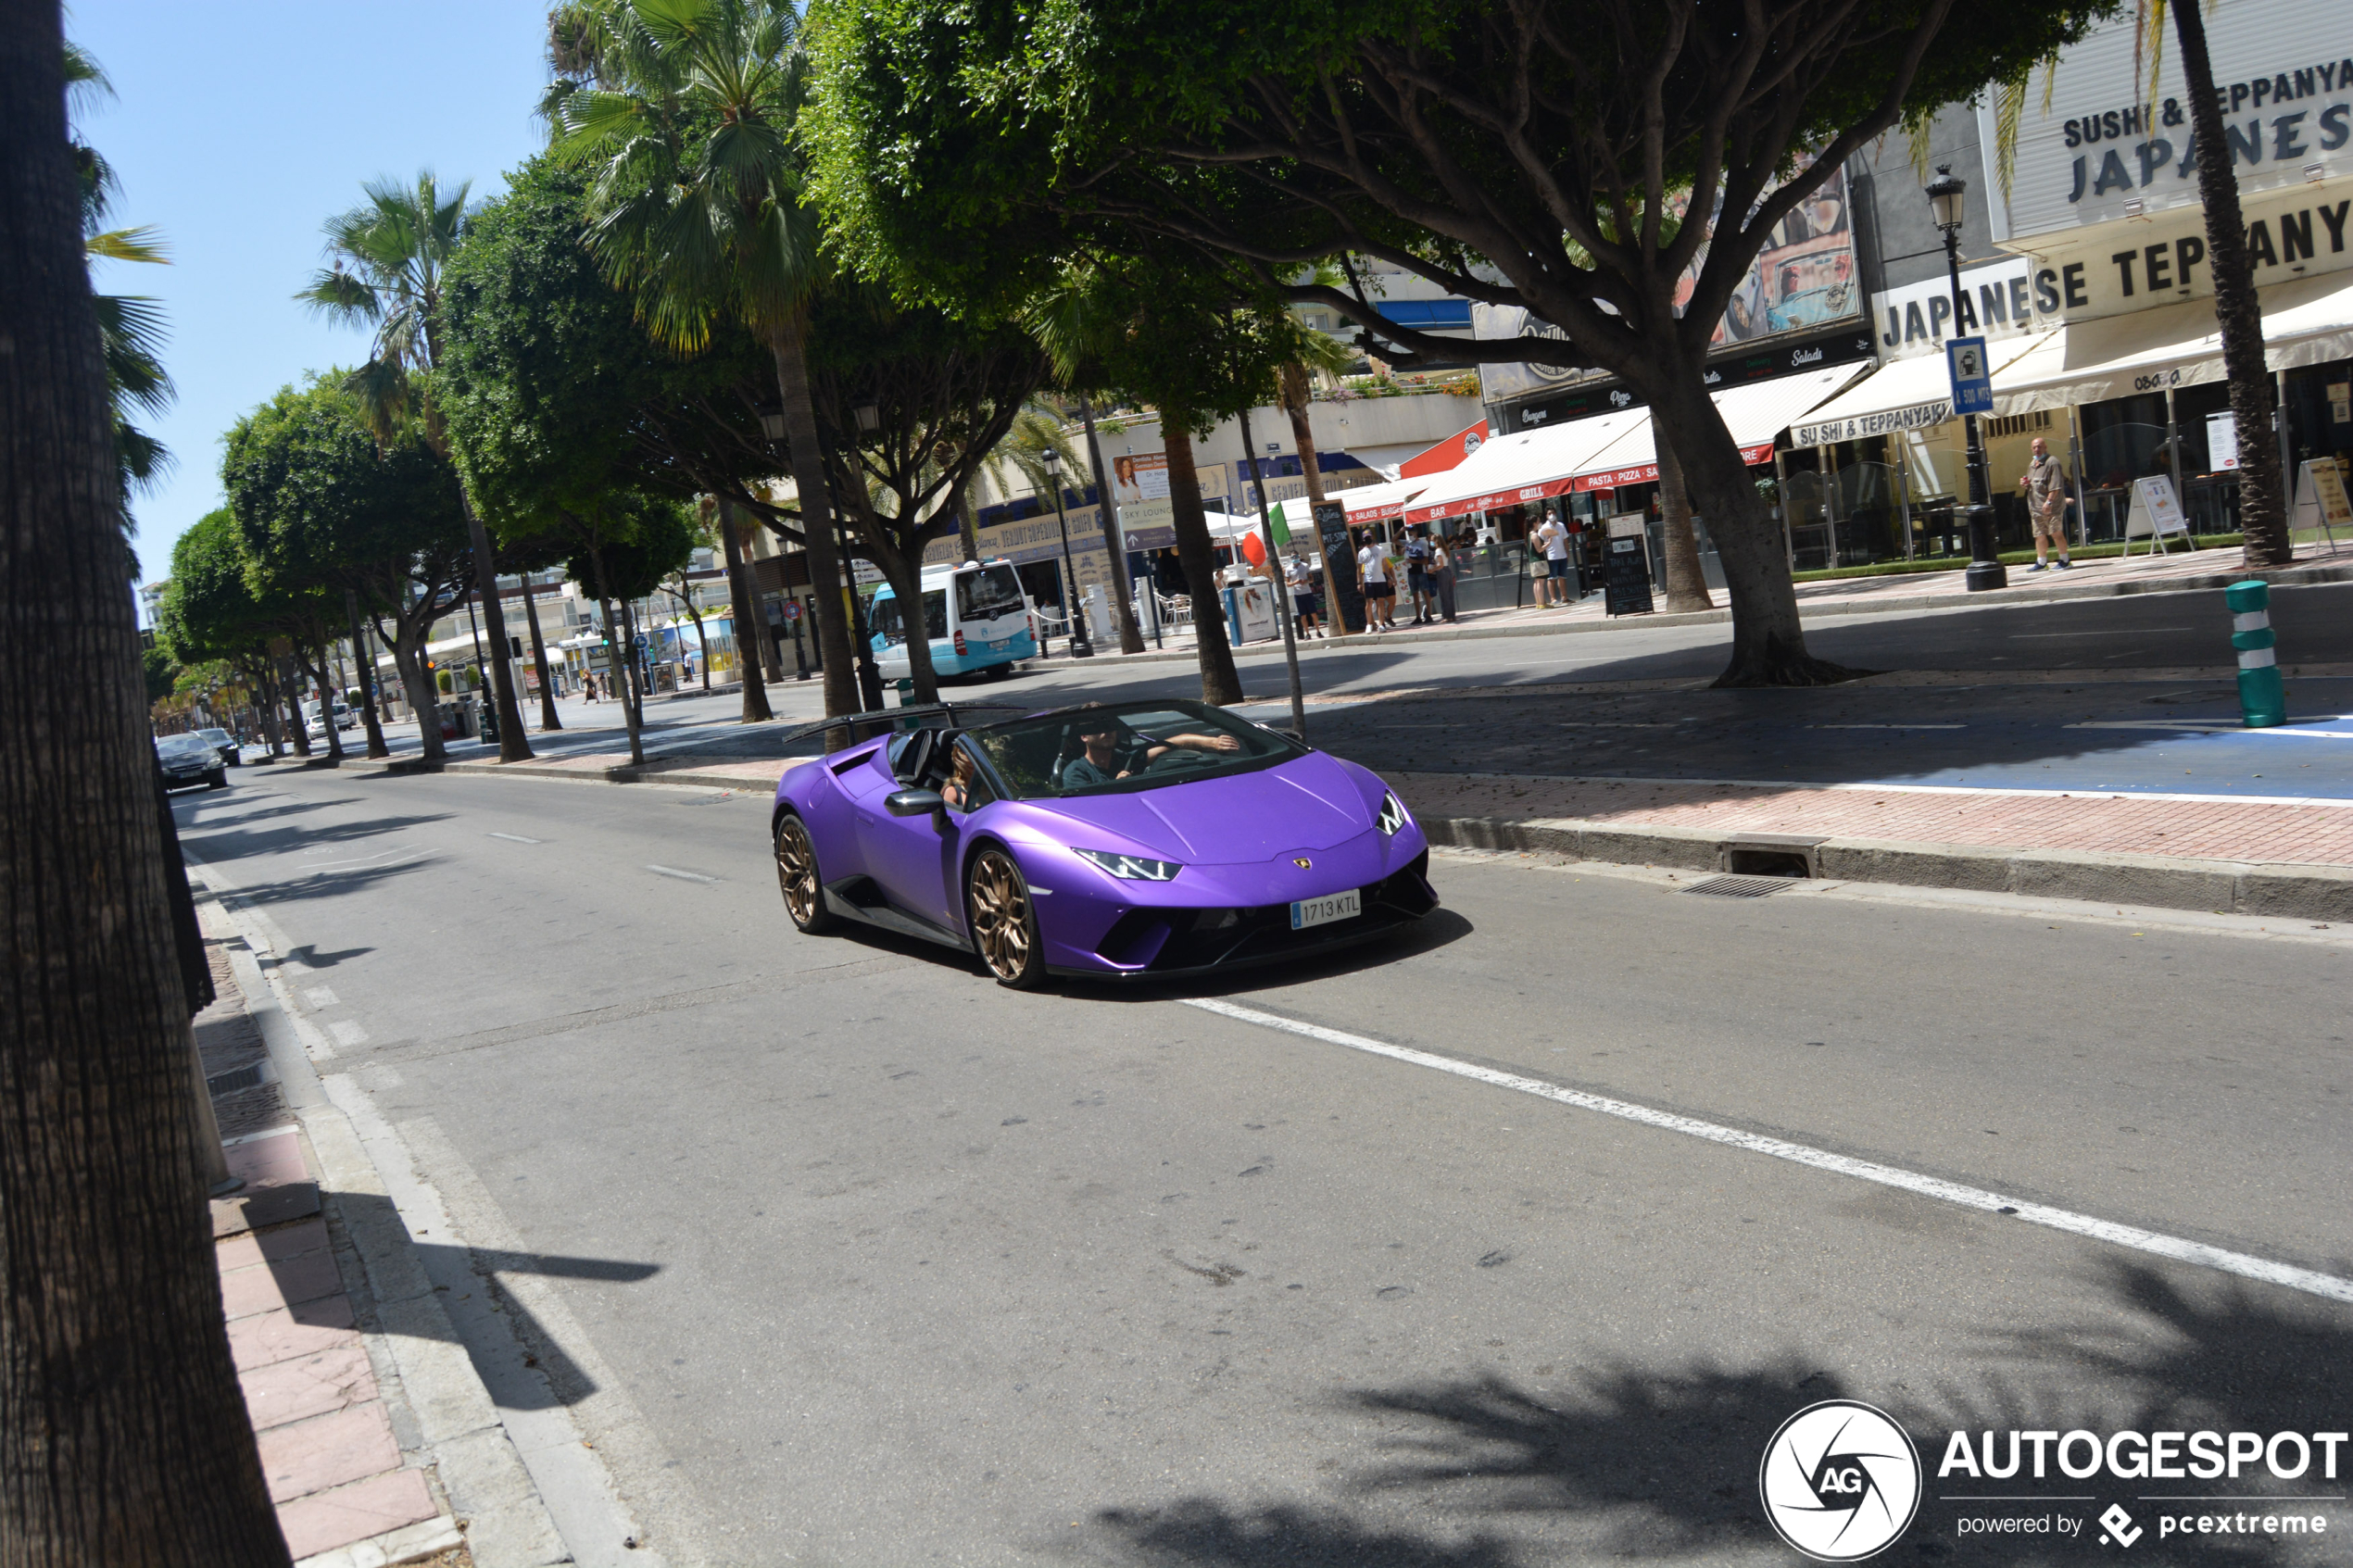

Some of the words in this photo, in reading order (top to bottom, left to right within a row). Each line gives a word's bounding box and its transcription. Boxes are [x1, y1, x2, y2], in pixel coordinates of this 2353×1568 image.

[2063, 103, 2151, 148] SUSHI
[2161, 97, 2184, 128] &
[2215, 58, 2353, 115] EPPANYA
[1882, 262, 2089, 347] JAPANESE
[2111, 200, 2351, 297] TEPANY
[1791, 346, 1823, 367] Salads
[1703, 370, 1721, 384] asta
[1609, 390, 1632, 408] Pizza
[1956, 390, 1961, 406] A
[1963, 388, 1976, 405] 500
[1977, 386, 1992, 403] MTS
[1521, 408, 1547, 425] Burgers
[1846, 420, 1856, 437] &
[1859, 402, 1946, 435] TEPPANYAKI
[1588, 471, 1614, 487] PASTA
[1618, 469, 1642, 481] PIZZA
[1519, 486, 1544, 500] GRILL
[1125, 509, 1139, 520] SKY
[1355, 508, 1378, 521] SALADS
[1430, 506, 1446, 519] BAR
[1304, 901, 1334, 922] 1713
[1337, 896, 1360, 915] KTL
